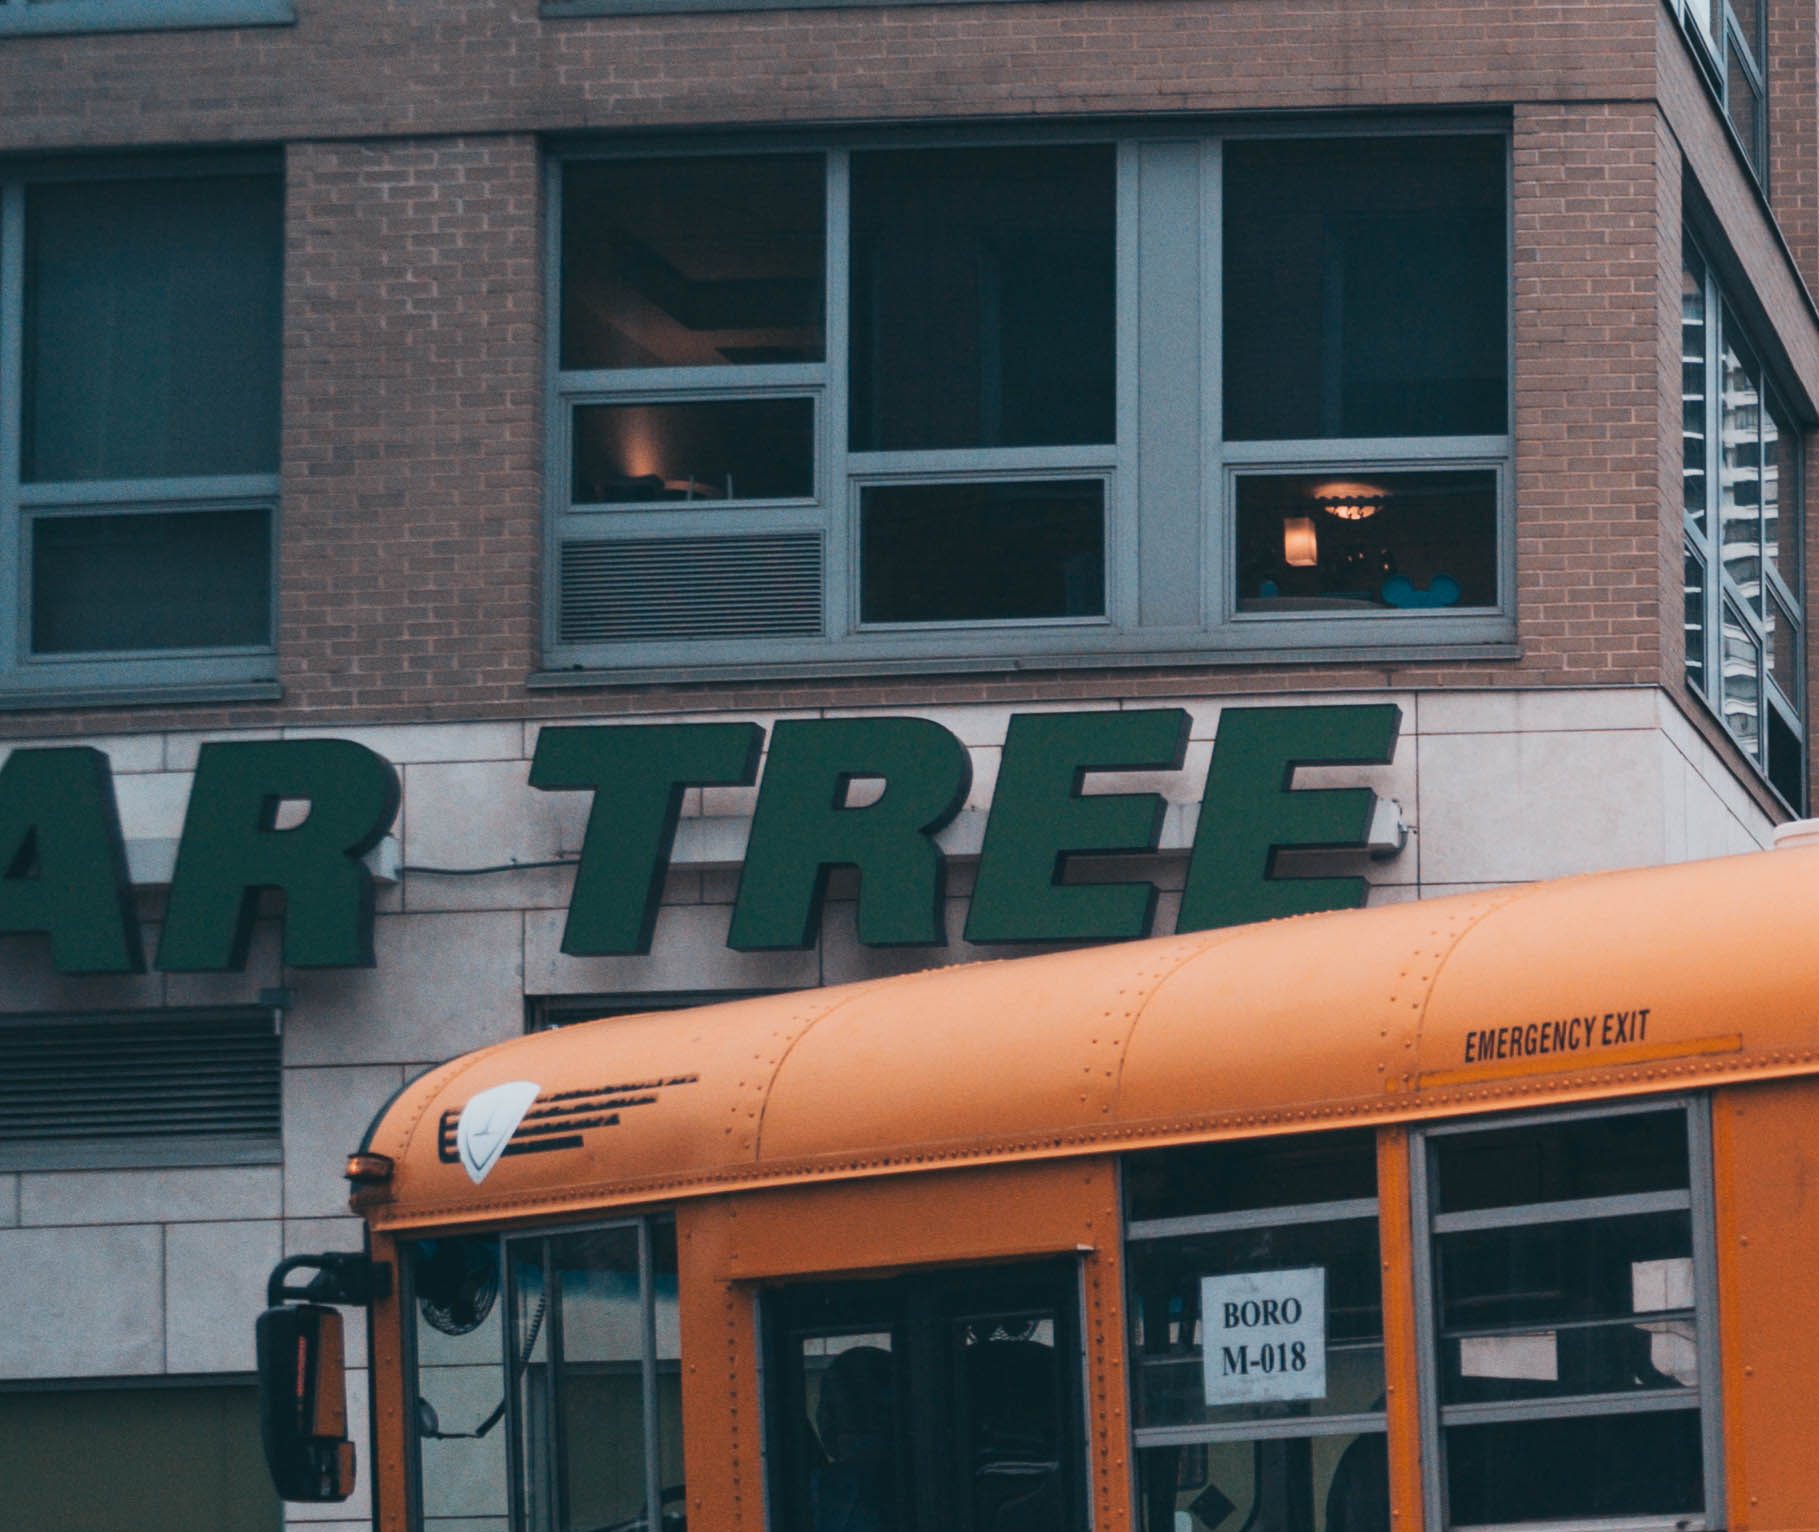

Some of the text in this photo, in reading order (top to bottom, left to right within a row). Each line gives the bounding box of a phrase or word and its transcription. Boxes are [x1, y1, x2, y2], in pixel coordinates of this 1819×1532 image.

[528, 703, 1402, 956] TREE
[1464, 1009, 1650, 1063] EMERGENCY EXIT
[1223, 1297, 1302, 1329] BORO
[1222, 1340, 1307, 1376] M-018
